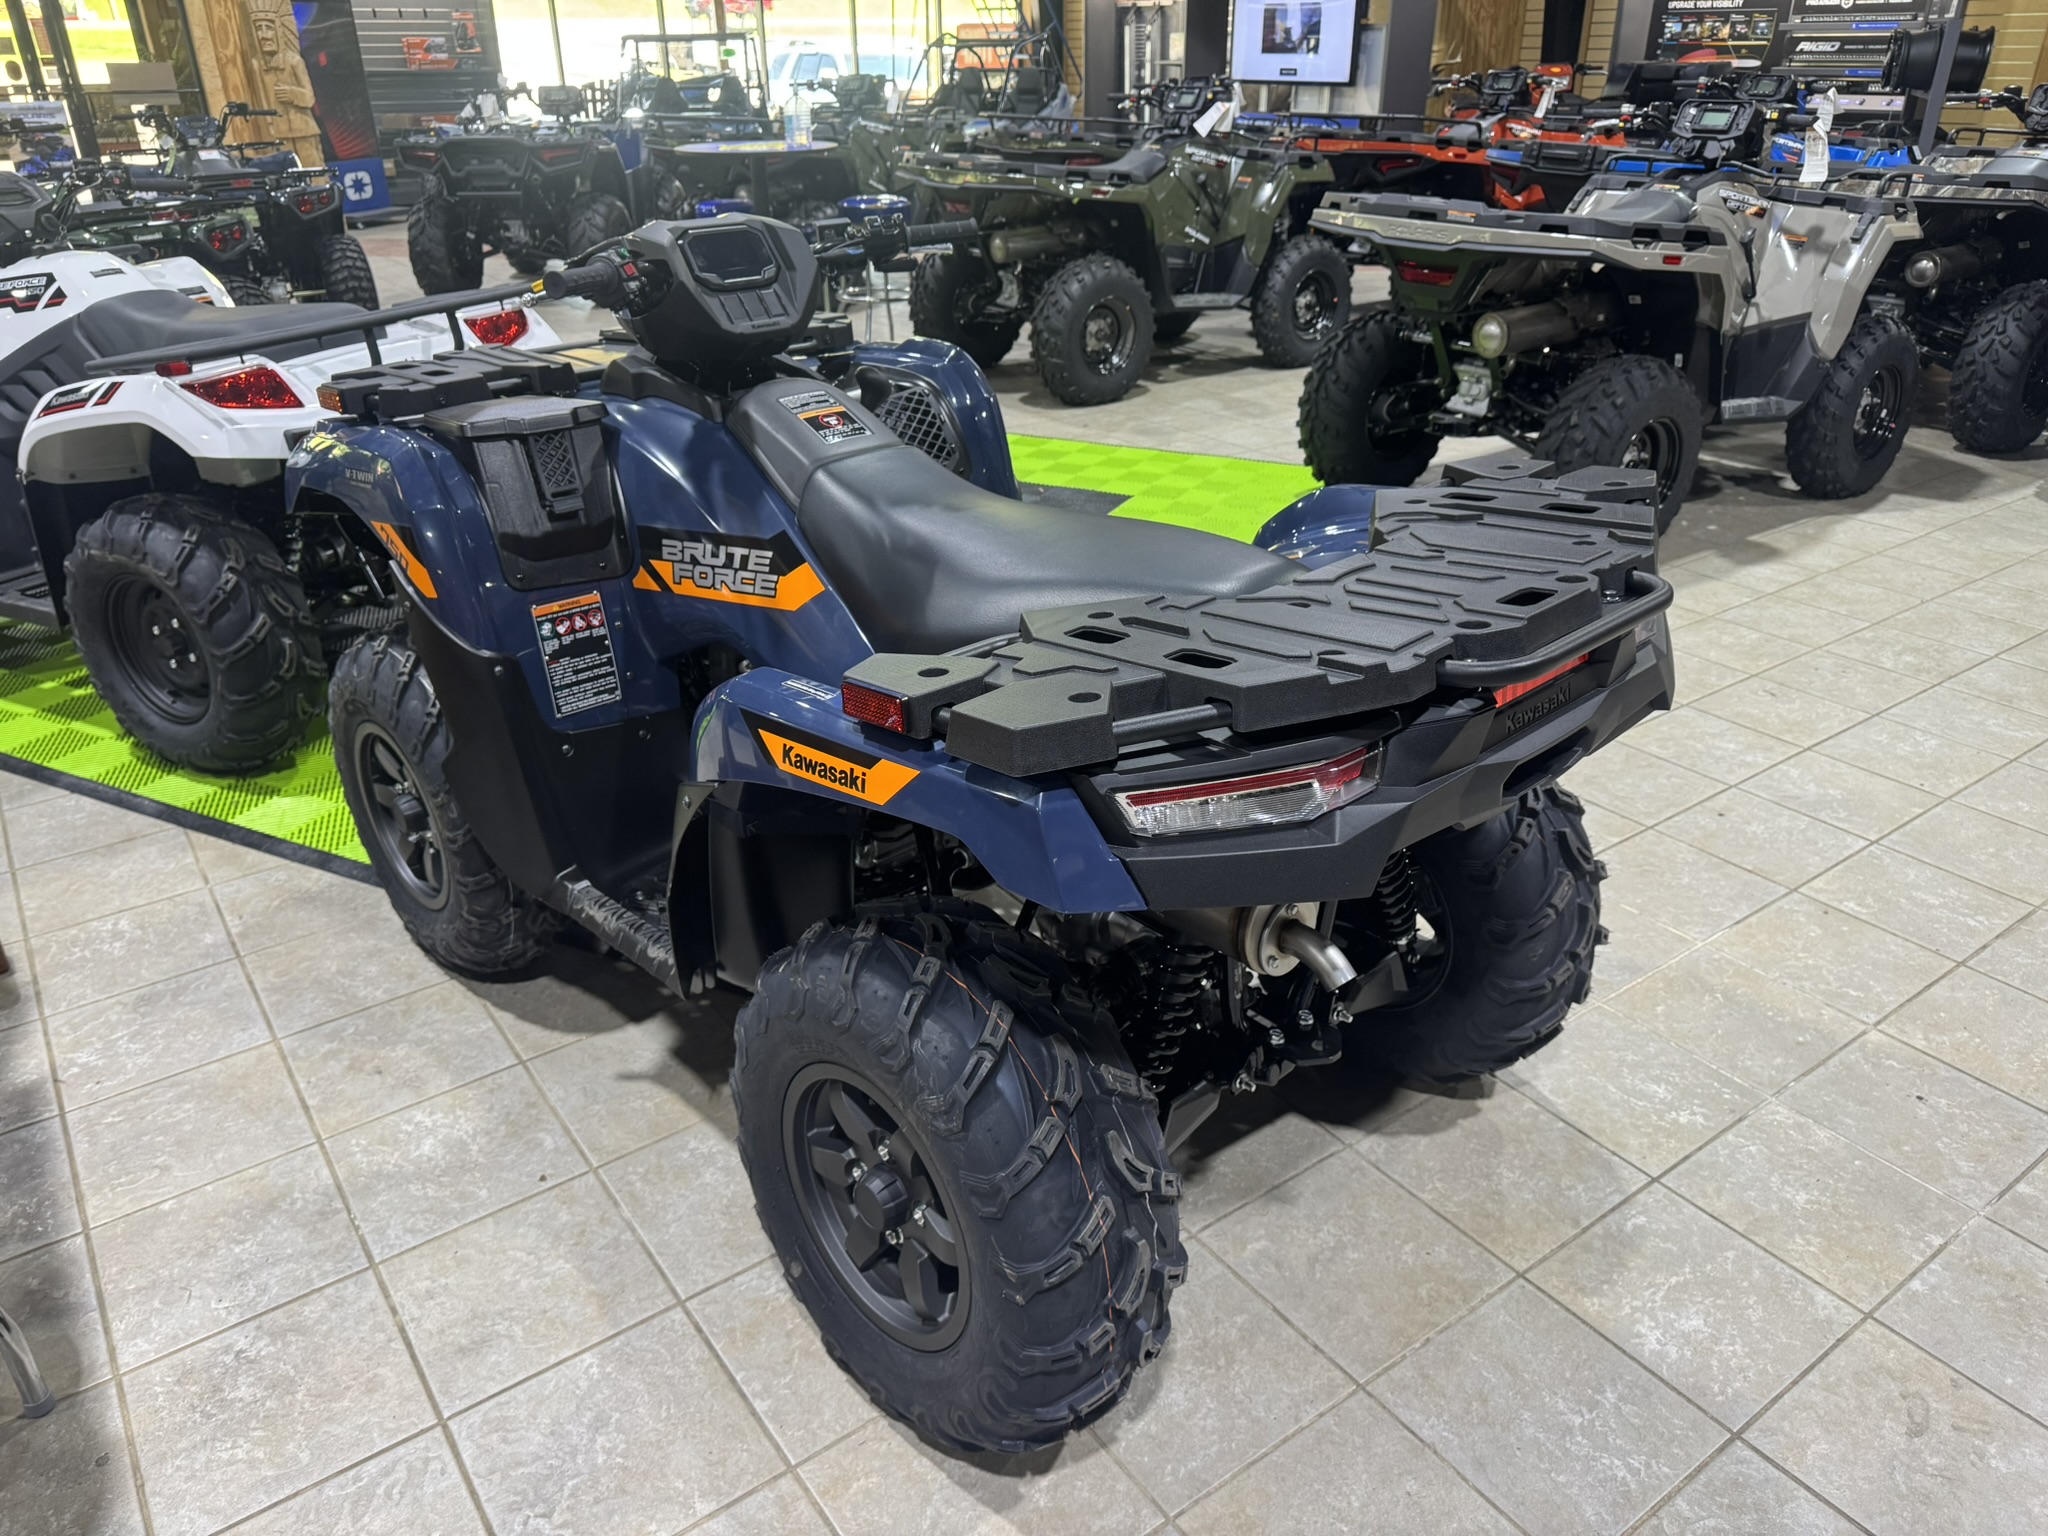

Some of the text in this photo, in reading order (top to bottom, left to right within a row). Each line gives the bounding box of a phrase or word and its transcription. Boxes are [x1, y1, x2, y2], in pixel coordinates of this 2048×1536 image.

[1668, 0, 1744, 9] UPGRADE YOUR VISIBILITY
[1795, 41, 1841, 52] RIGID
[1719, 188, 1773, 208] SPORTSMAN
[344, 468, 374, 483] V-TWIN
[661, 538, 774, 573] BRUTE
[672, 562, 779, 597] FORCE
[1505, 682, 1571, 735] Kawasaki
[782, 742, 867, 794] Kawasaki
